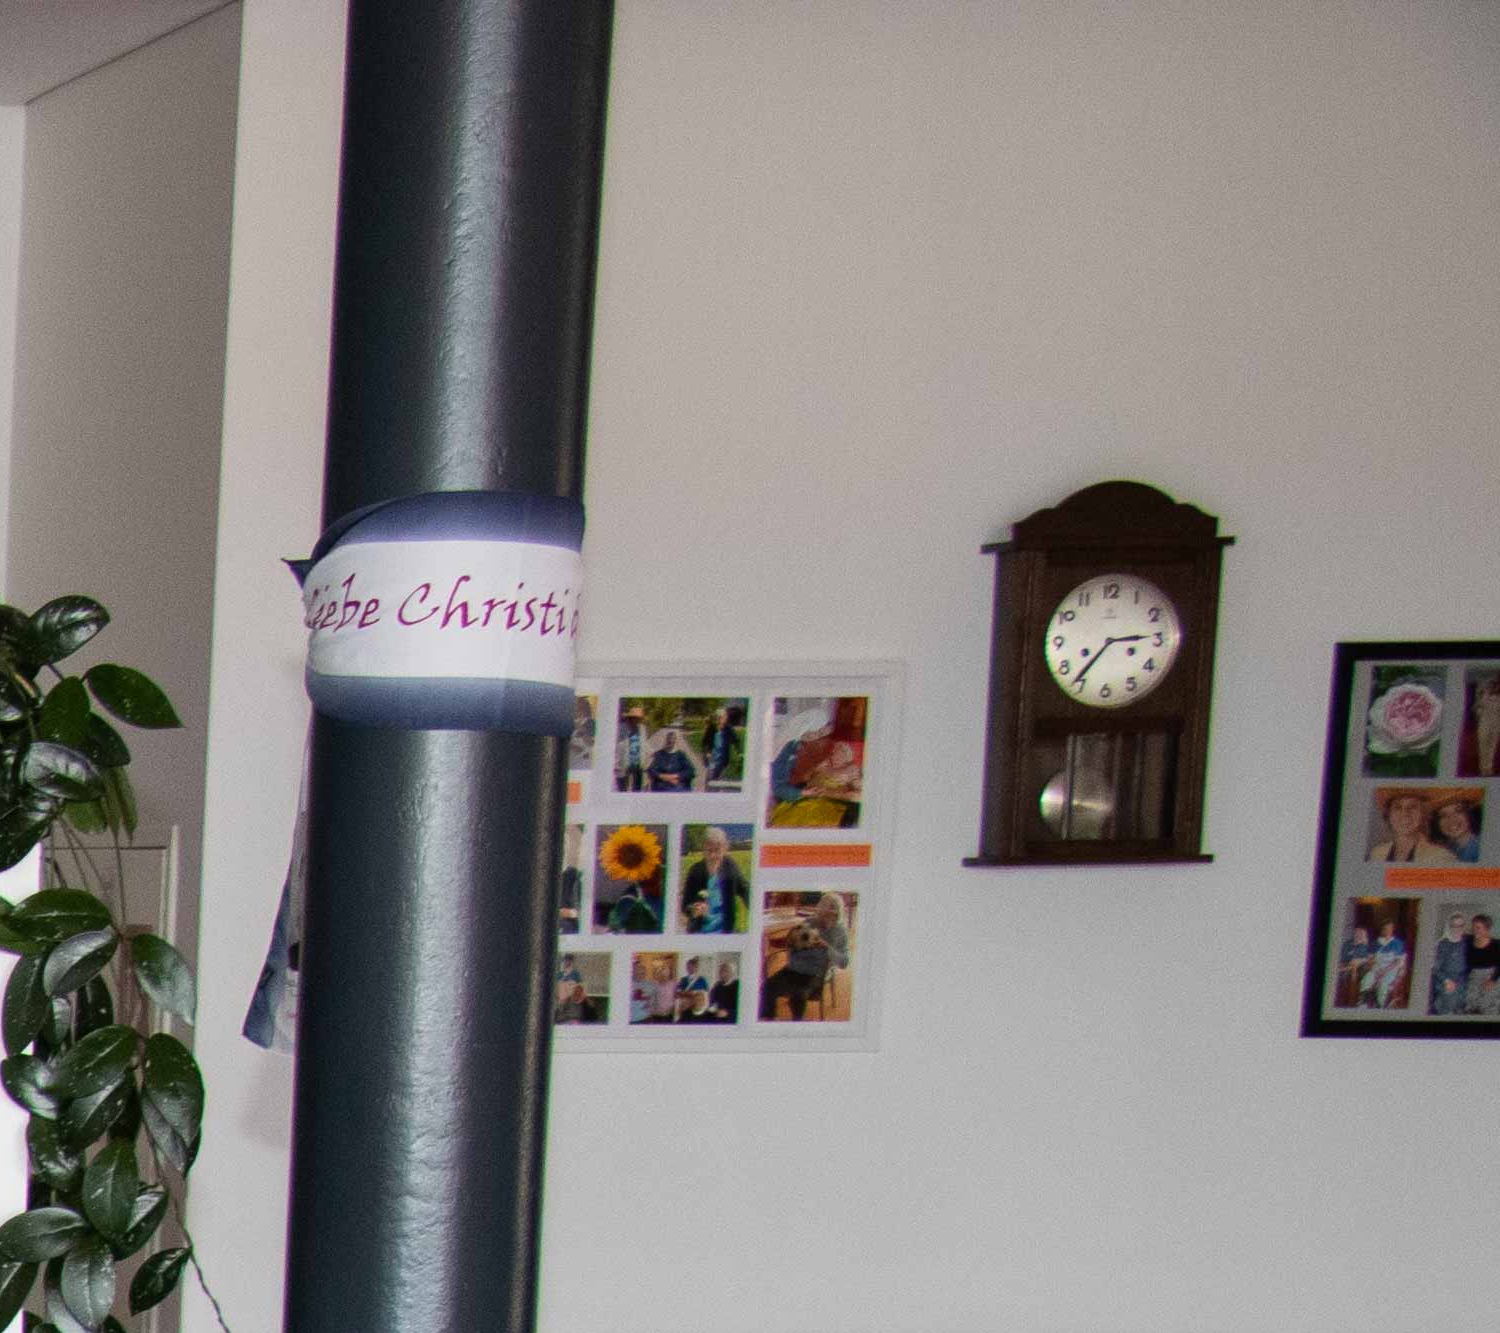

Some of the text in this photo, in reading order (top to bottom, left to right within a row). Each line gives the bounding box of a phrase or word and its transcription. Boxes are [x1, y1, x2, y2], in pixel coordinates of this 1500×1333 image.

[1078, 591, 1090, 607] 11
[1103, 583, 1120, 599] 12
[1133, 590, 1140, 605] 1
[1058, 609, 1075, 625] 10
[1148, 607, 1161, 622] 2
[1053, 635, 1065, 651] 9
[1152, 631, 1164, 648] 3
[1058, 660, 1071, 676] 8
[1143, 657, 1155, 671] 4
[1075, 677, 1087, 694] 7
[1100, 683, 1112, 699] 6
[1125, 676, 1138, 692] 5
